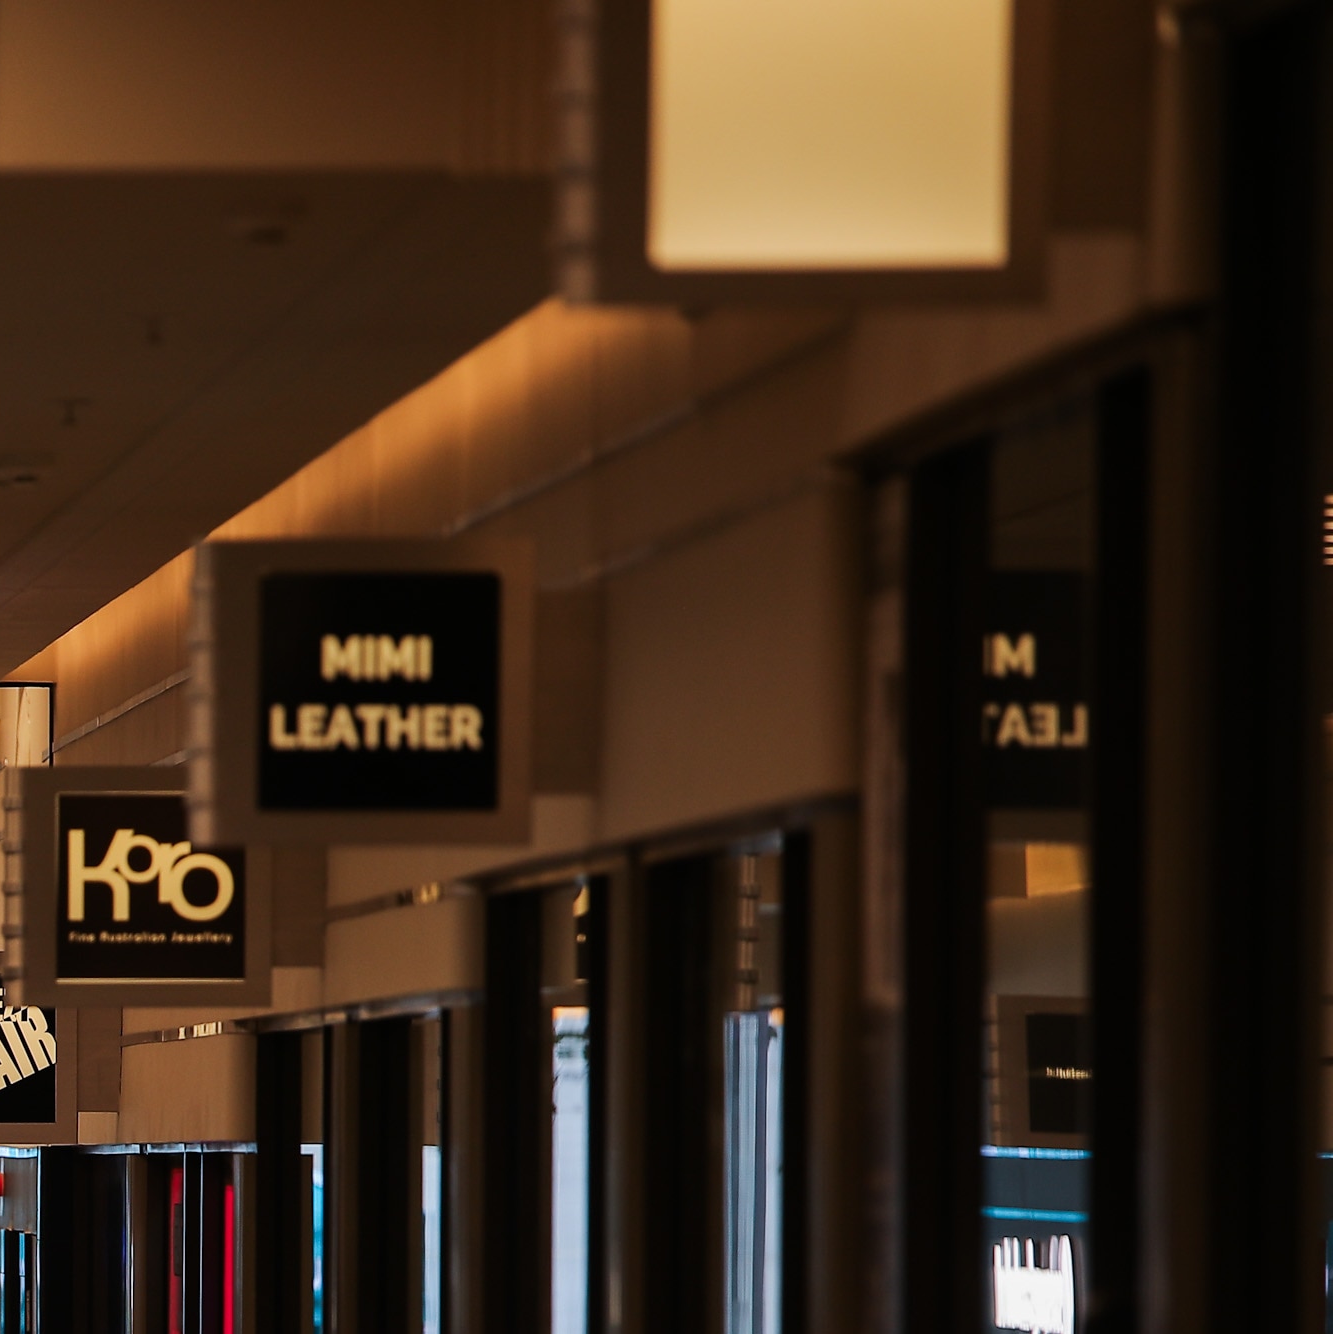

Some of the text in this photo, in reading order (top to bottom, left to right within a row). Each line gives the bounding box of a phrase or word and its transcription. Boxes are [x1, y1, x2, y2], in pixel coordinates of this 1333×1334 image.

[321, 634, 433, 683] MIMI
[269, 704, 484, 752] LEATHER
[68, 931, 97, 943] Fine
[170, 931, 234, 945] Jewellery
